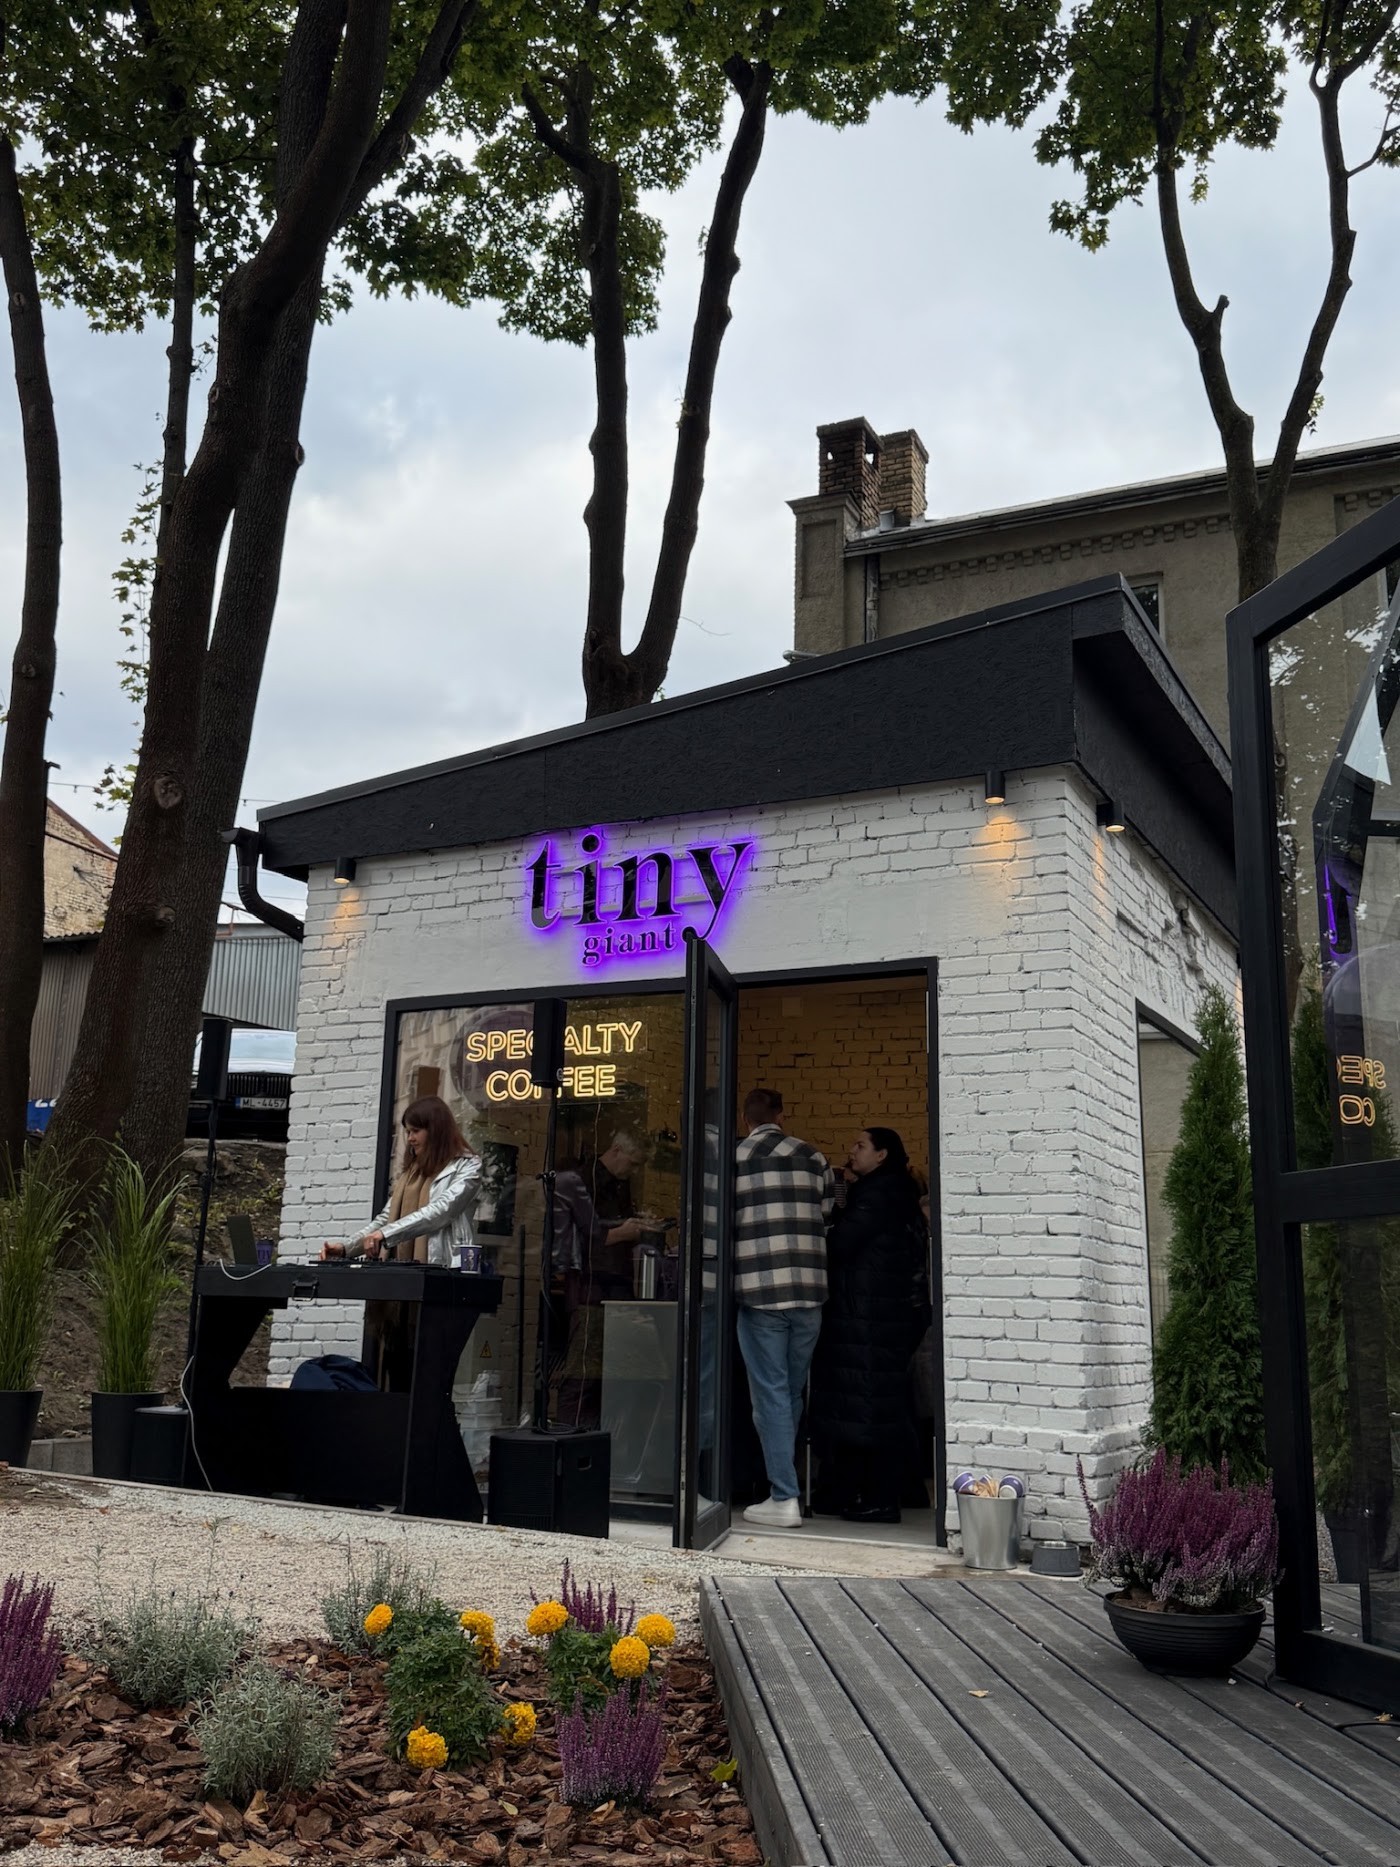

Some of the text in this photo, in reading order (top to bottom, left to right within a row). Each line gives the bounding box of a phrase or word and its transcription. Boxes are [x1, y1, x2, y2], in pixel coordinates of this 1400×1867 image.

[526, 834, 753, 943] tiny
[582, 922, 676, 966] giant
[466, 1021, 642, 1062] SPEALTY
[486, 1064, 616, 1101] COFEE
